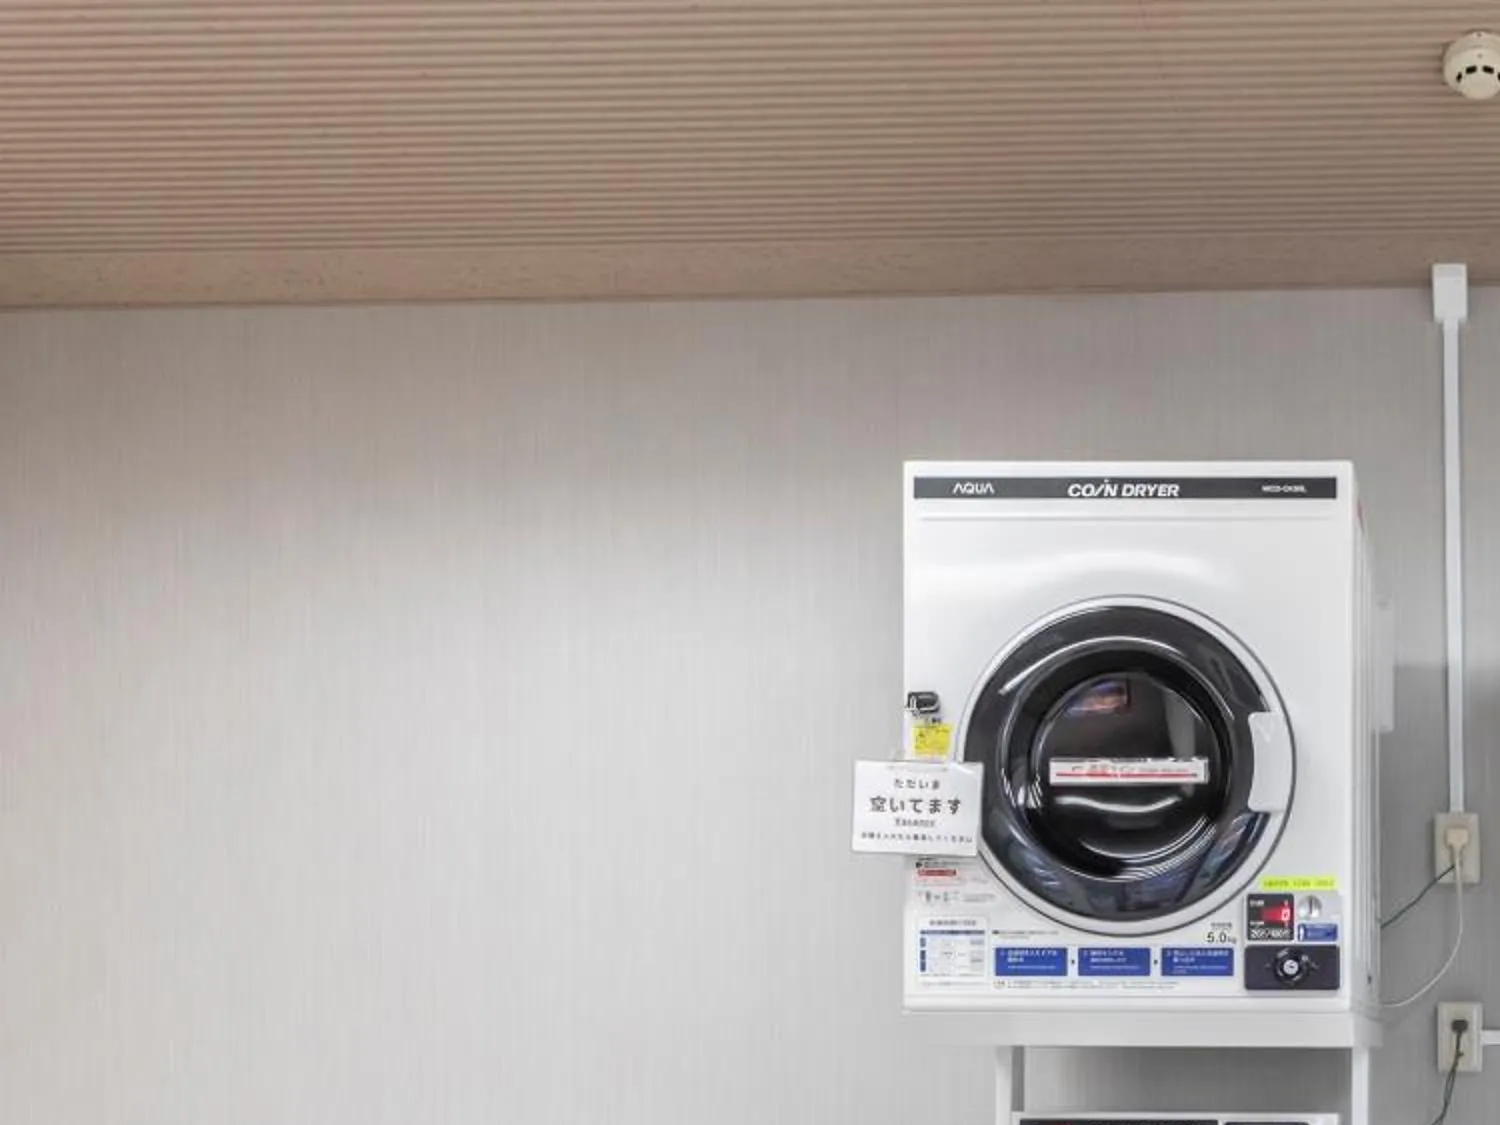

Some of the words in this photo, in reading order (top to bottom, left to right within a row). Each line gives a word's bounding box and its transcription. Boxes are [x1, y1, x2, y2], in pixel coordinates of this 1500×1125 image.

[953, 482, 995, 495] AQUA
[1121, 483, 1180, 498] DRYER
[893, 778, 941, 790] ただいま
[869, 795, 962, 815] 空いてます
